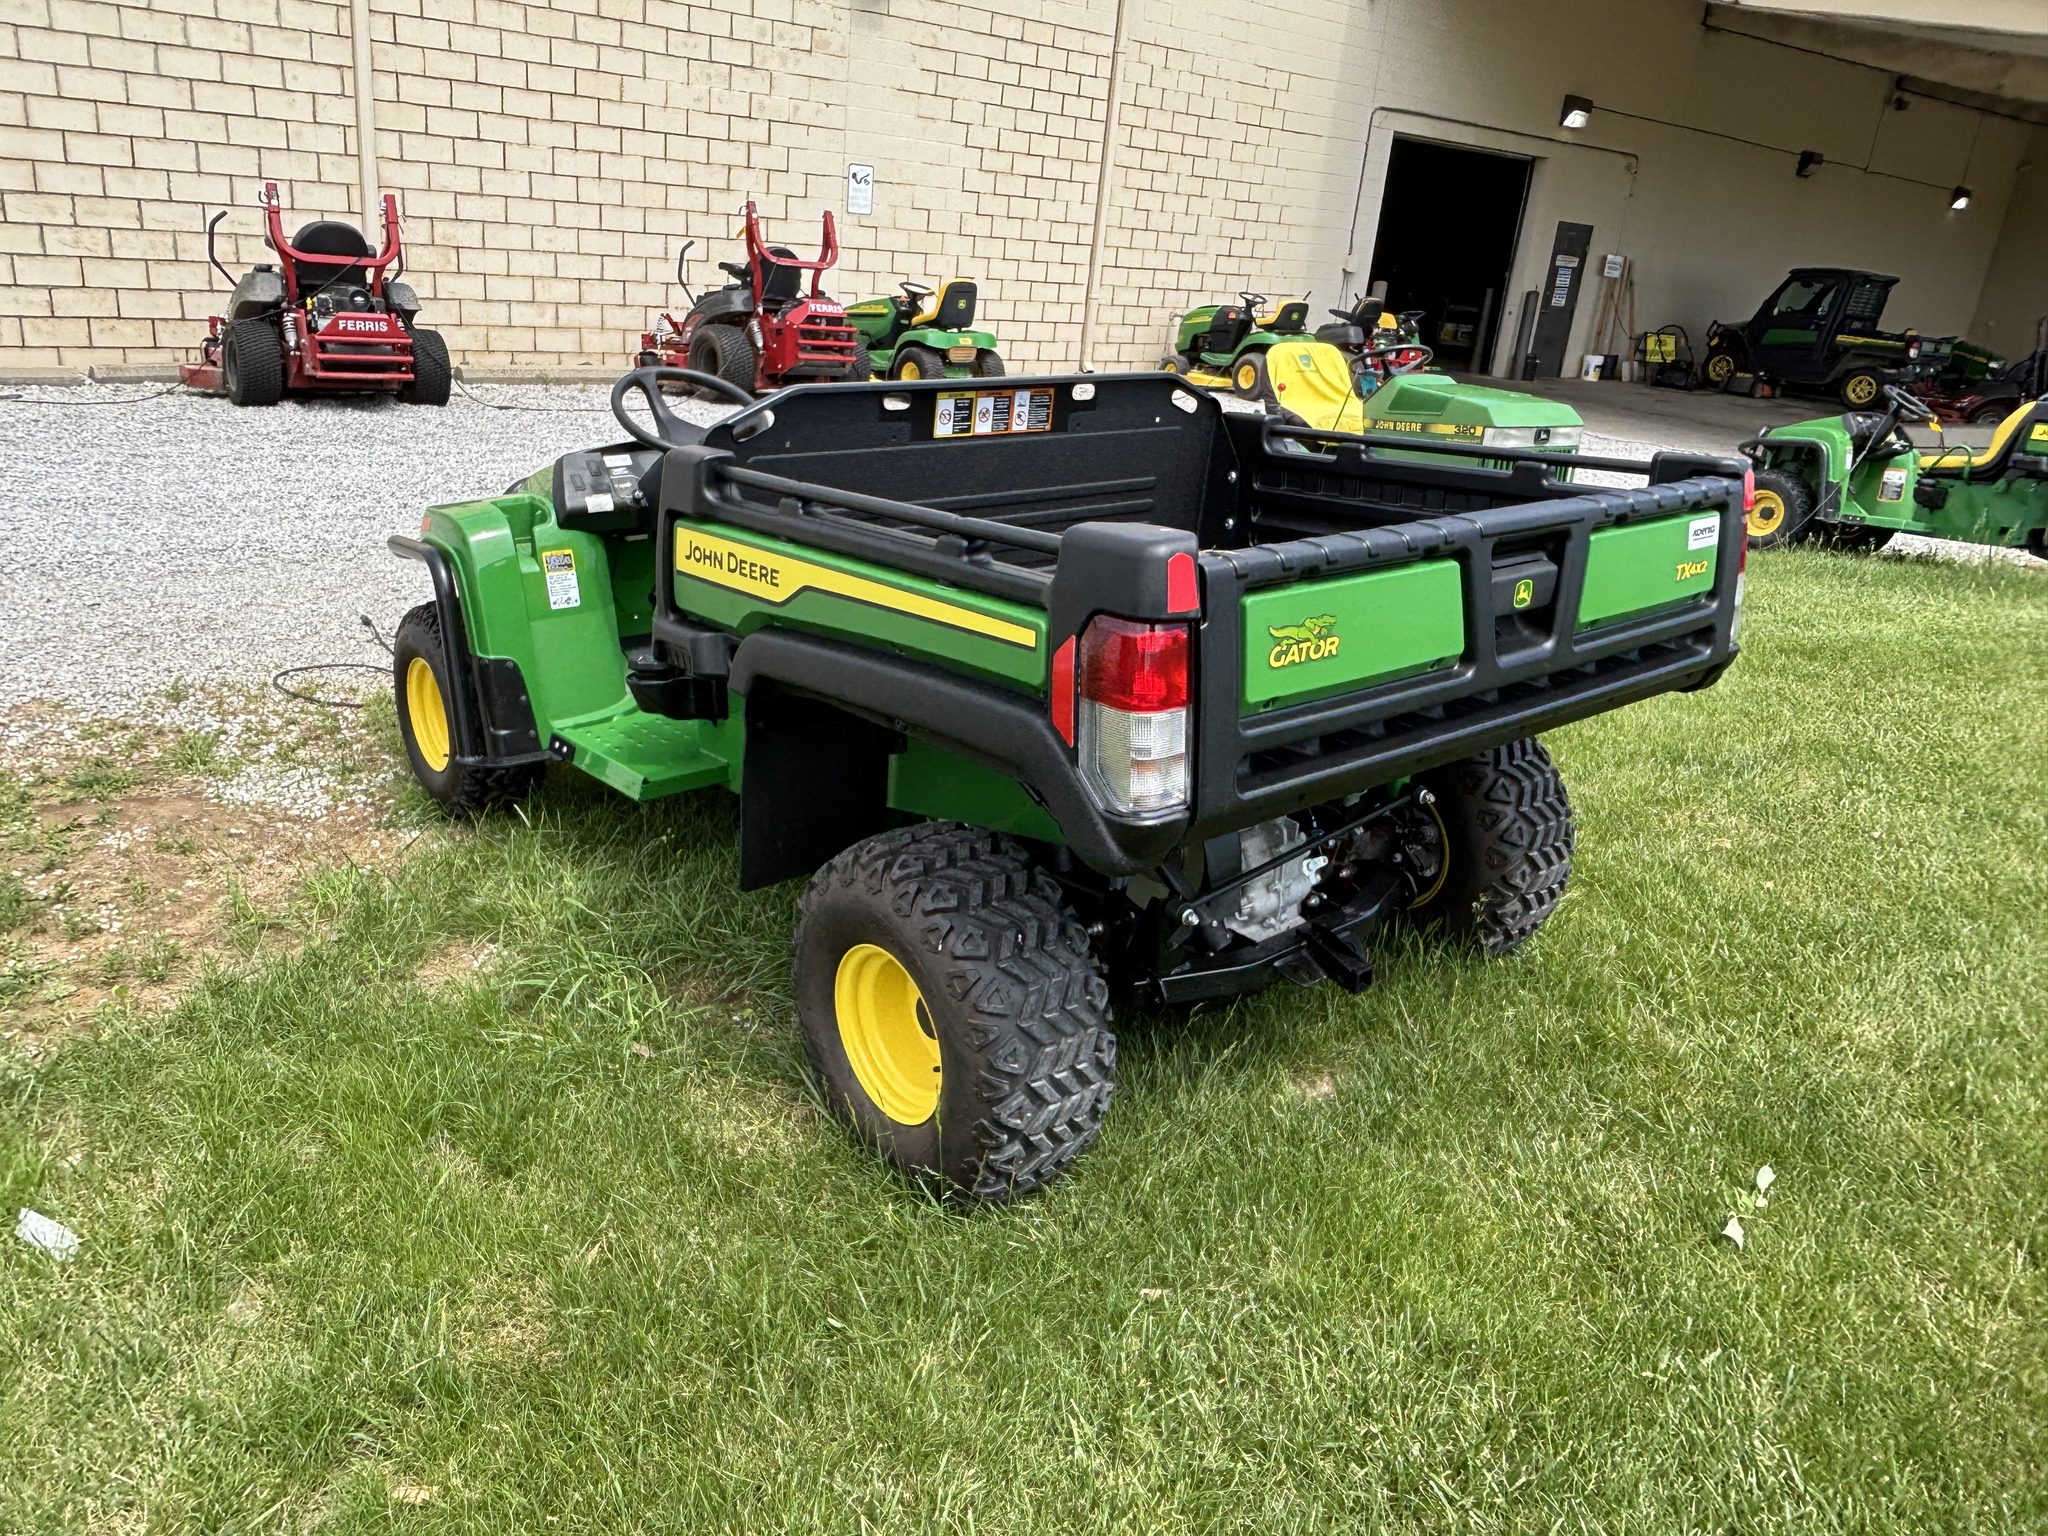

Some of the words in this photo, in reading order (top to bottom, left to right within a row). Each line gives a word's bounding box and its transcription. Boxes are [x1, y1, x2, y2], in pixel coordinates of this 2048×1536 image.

[338, 319, 389, 332] FERRIS
[1375, 420, 1394, 430] JOHN
[1395, 421, 1422, 432] DEERE
[1453, 425, 1476, 435] 320
[684, 540, 723, 570] JOHN
[727, 551, 780, 588] DEERE
[1268, 635, 1340, 669] GATOR
